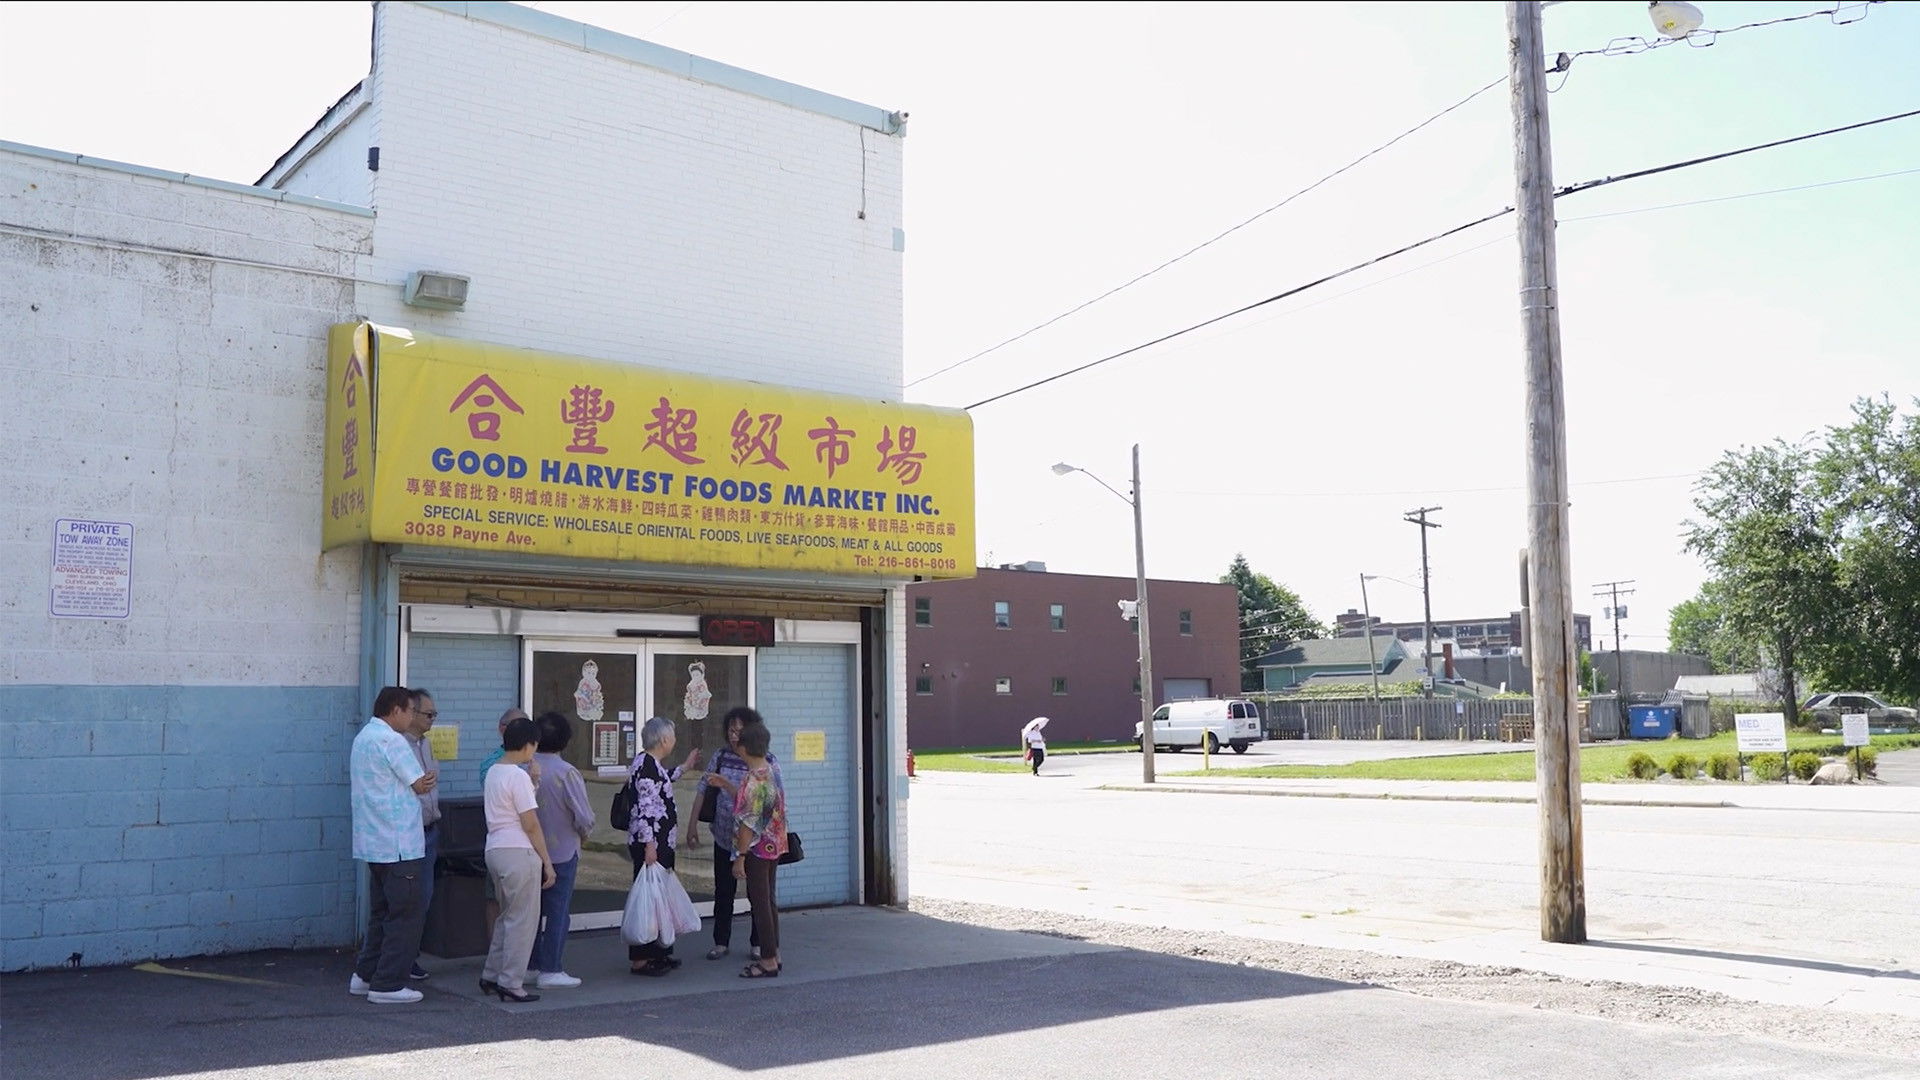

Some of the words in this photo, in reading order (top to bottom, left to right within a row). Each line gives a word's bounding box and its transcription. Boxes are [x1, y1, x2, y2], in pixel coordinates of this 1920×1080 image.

[449, 373, 927, 486] 合豐超級市場
[431, 447, 528, 480] GOOD
[540, 459, 674, 495] HARVEST
[685, 475, 772, 504] FOODS
[783, 484, 887, 512] MARKET
[896, 494, 940, 515] INC.
[60, 533, 79, 544] TOW
[81, 535, 103, 545] AWAY
[106, 537, 129, 547] ZONE
[70, 523, 120, 535] PRIVATE
[405, 521, 446, 537] 3038
[453, 525, 499, 544] Payne
[506, 530, 536, 546] Ave.
[423, 504, 483, 522] SPECIAL
[488, 510, 549, 528] SERVICE:
[554, 516, 633, 535] WHOLESALE
[637, 523, 695, 540] ORIENTAL
[700, 528, 743, 544] FOODS,
[747, 531, 771, 544] LIVE
[775, 533, 838, 549] SEAFOODS,
[841, 538, 869, 550] MEAT
[873, 540, 880, 551] &
[884, 540, 903, 552] ALL
[906, 541, 943, 553] GOODS
[55, 566, 96, 575] ADVANCED
[99, 568, 128, 576] TOWING
[854, 554, 874, 567] Tel:
[878, 556, 956, 570] 216-861-8018
[707, 619, 772, 643] OPEN
